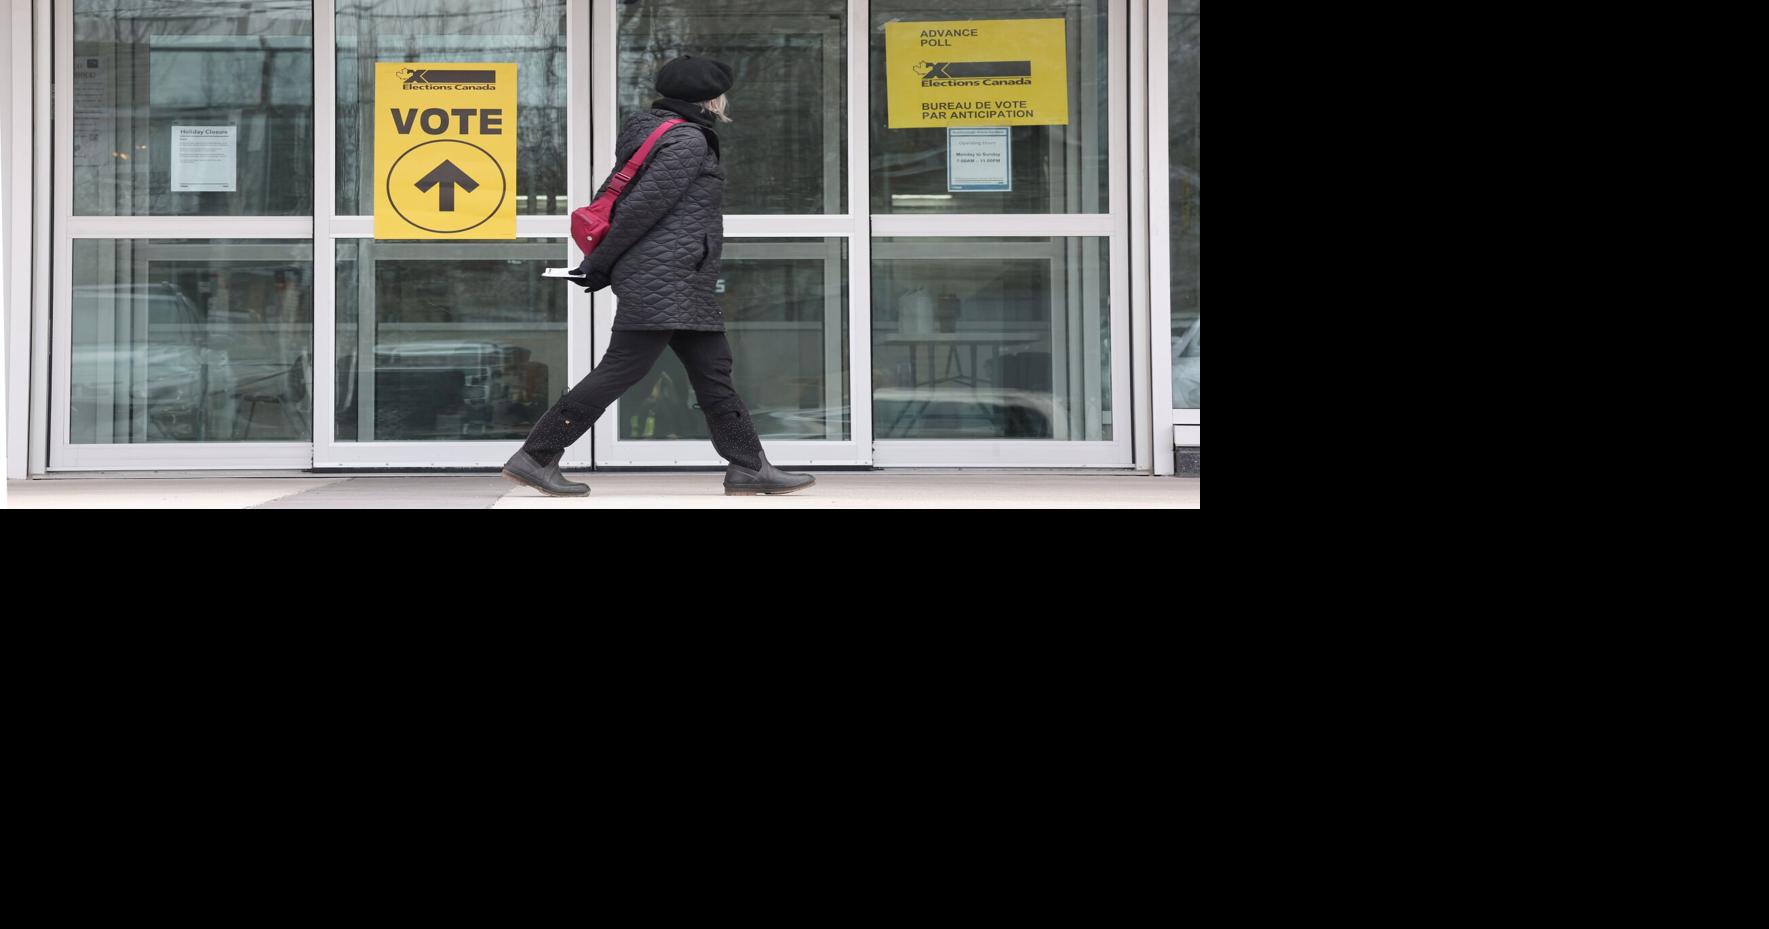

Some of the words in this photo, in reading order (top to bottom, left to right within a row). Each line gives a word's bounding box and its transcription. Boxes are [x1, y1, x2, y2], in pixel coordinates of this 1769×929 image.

[919, 28, 978, 38] ADVANCE
[920, 38, 952, 48] POLL
[402, 83, 452, 91] Elections
[454, 83, 496, 91] Canada
[921, 78, 980, 88] Elections
[982, 77, 1032, 86] Canada
[921, 101, 972, 111] BUREAU
[975, 101, 991, 110] DE
[994, 100, 1027, 109] VOTE
[922, 111, 947, 120] PAR
[950, 109, 1034, 119] ANTICIPATION
[389, 107, 503, 136] VOTE
